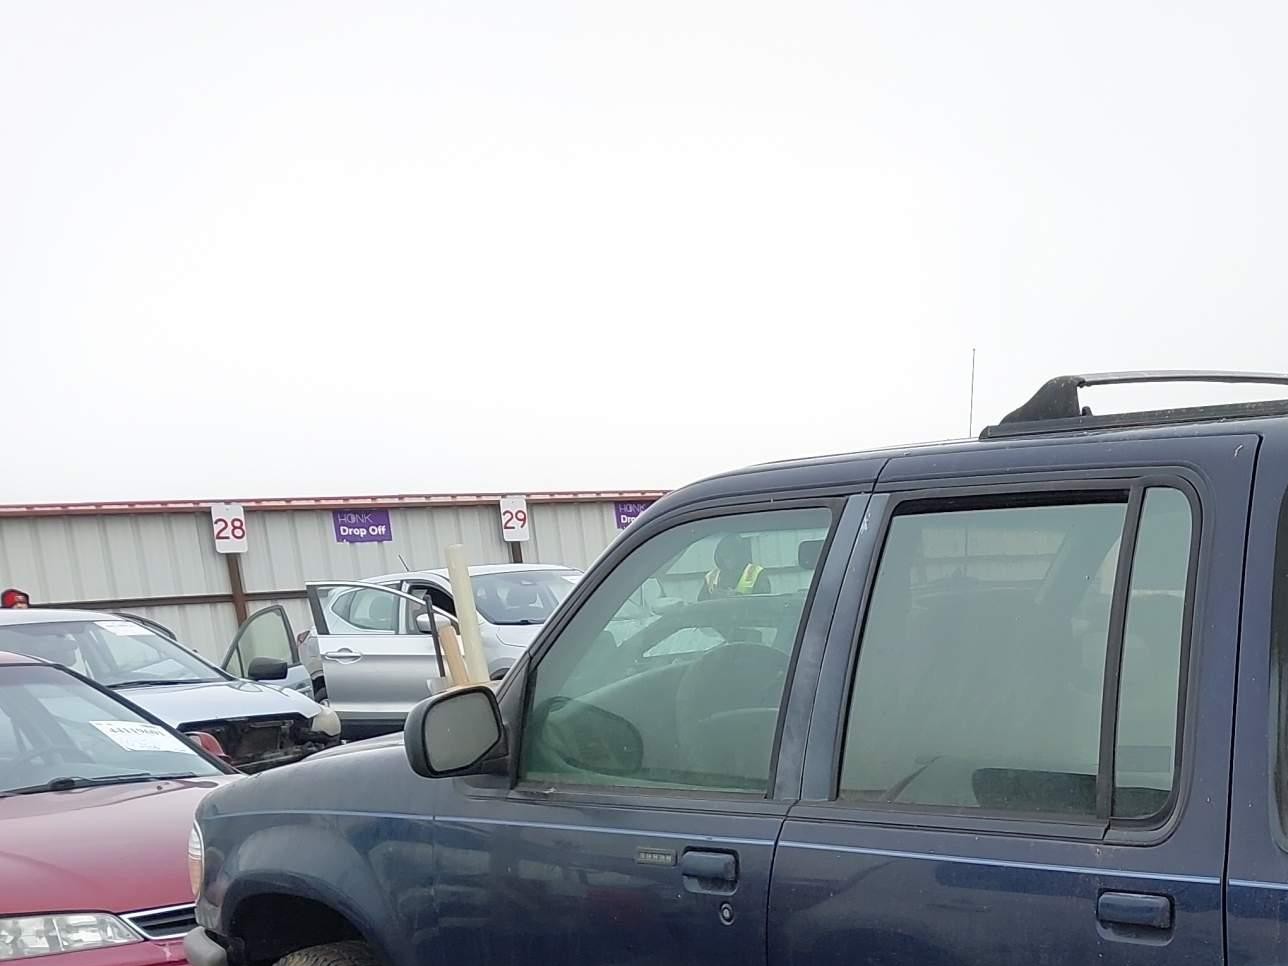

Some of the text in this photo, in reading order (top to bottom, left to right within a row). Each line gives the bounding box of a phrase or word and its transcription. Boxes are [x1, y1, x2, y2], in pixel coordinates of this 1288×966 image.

[337, 513, 373, 524] HONK
[503, 510, 527, 530] 29
[214, 518, 246, 540] 28
[340, 525, 387, 538] Drop Off
